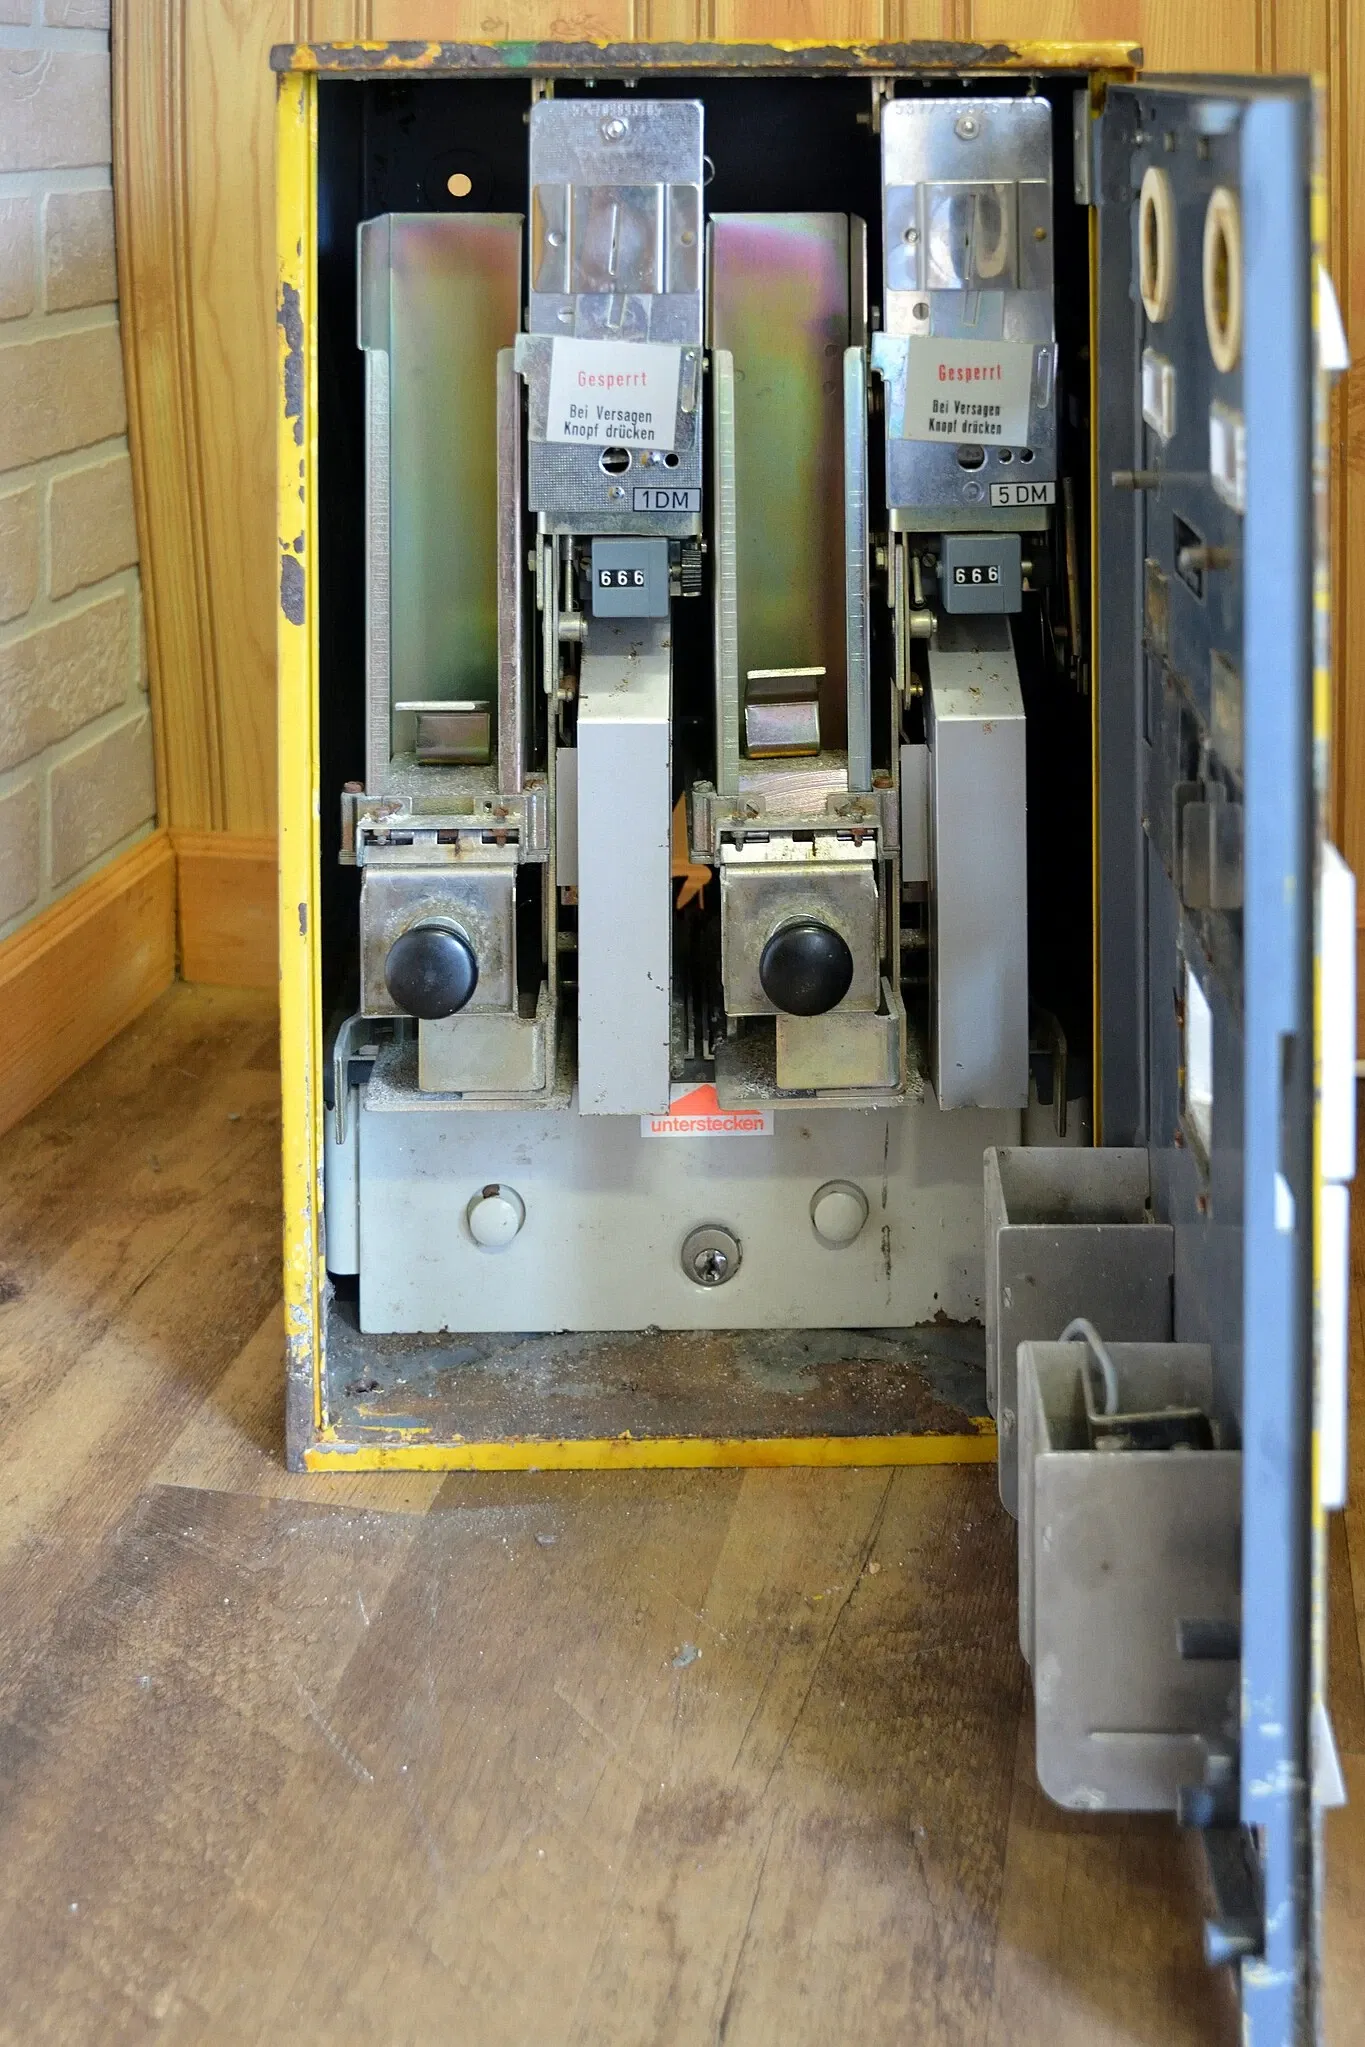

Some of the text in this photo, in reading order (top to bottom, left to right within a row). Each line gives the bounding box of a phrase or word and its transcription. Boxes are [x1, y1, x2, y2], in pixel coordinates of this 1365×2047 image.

[577, 370, 648, 389] Gesperrt
[938, 364, 1002, 383] Gesperrt
[569, 404, 653, 426] Bei Versagen
[932, 399, 1001, 418] Bei Versagen
[563, 420, 655, 441] Knopf drücken
[928, 417, 1002, 435] Knopf drücken
[650, 1115, 765, 1132] unterstecken
